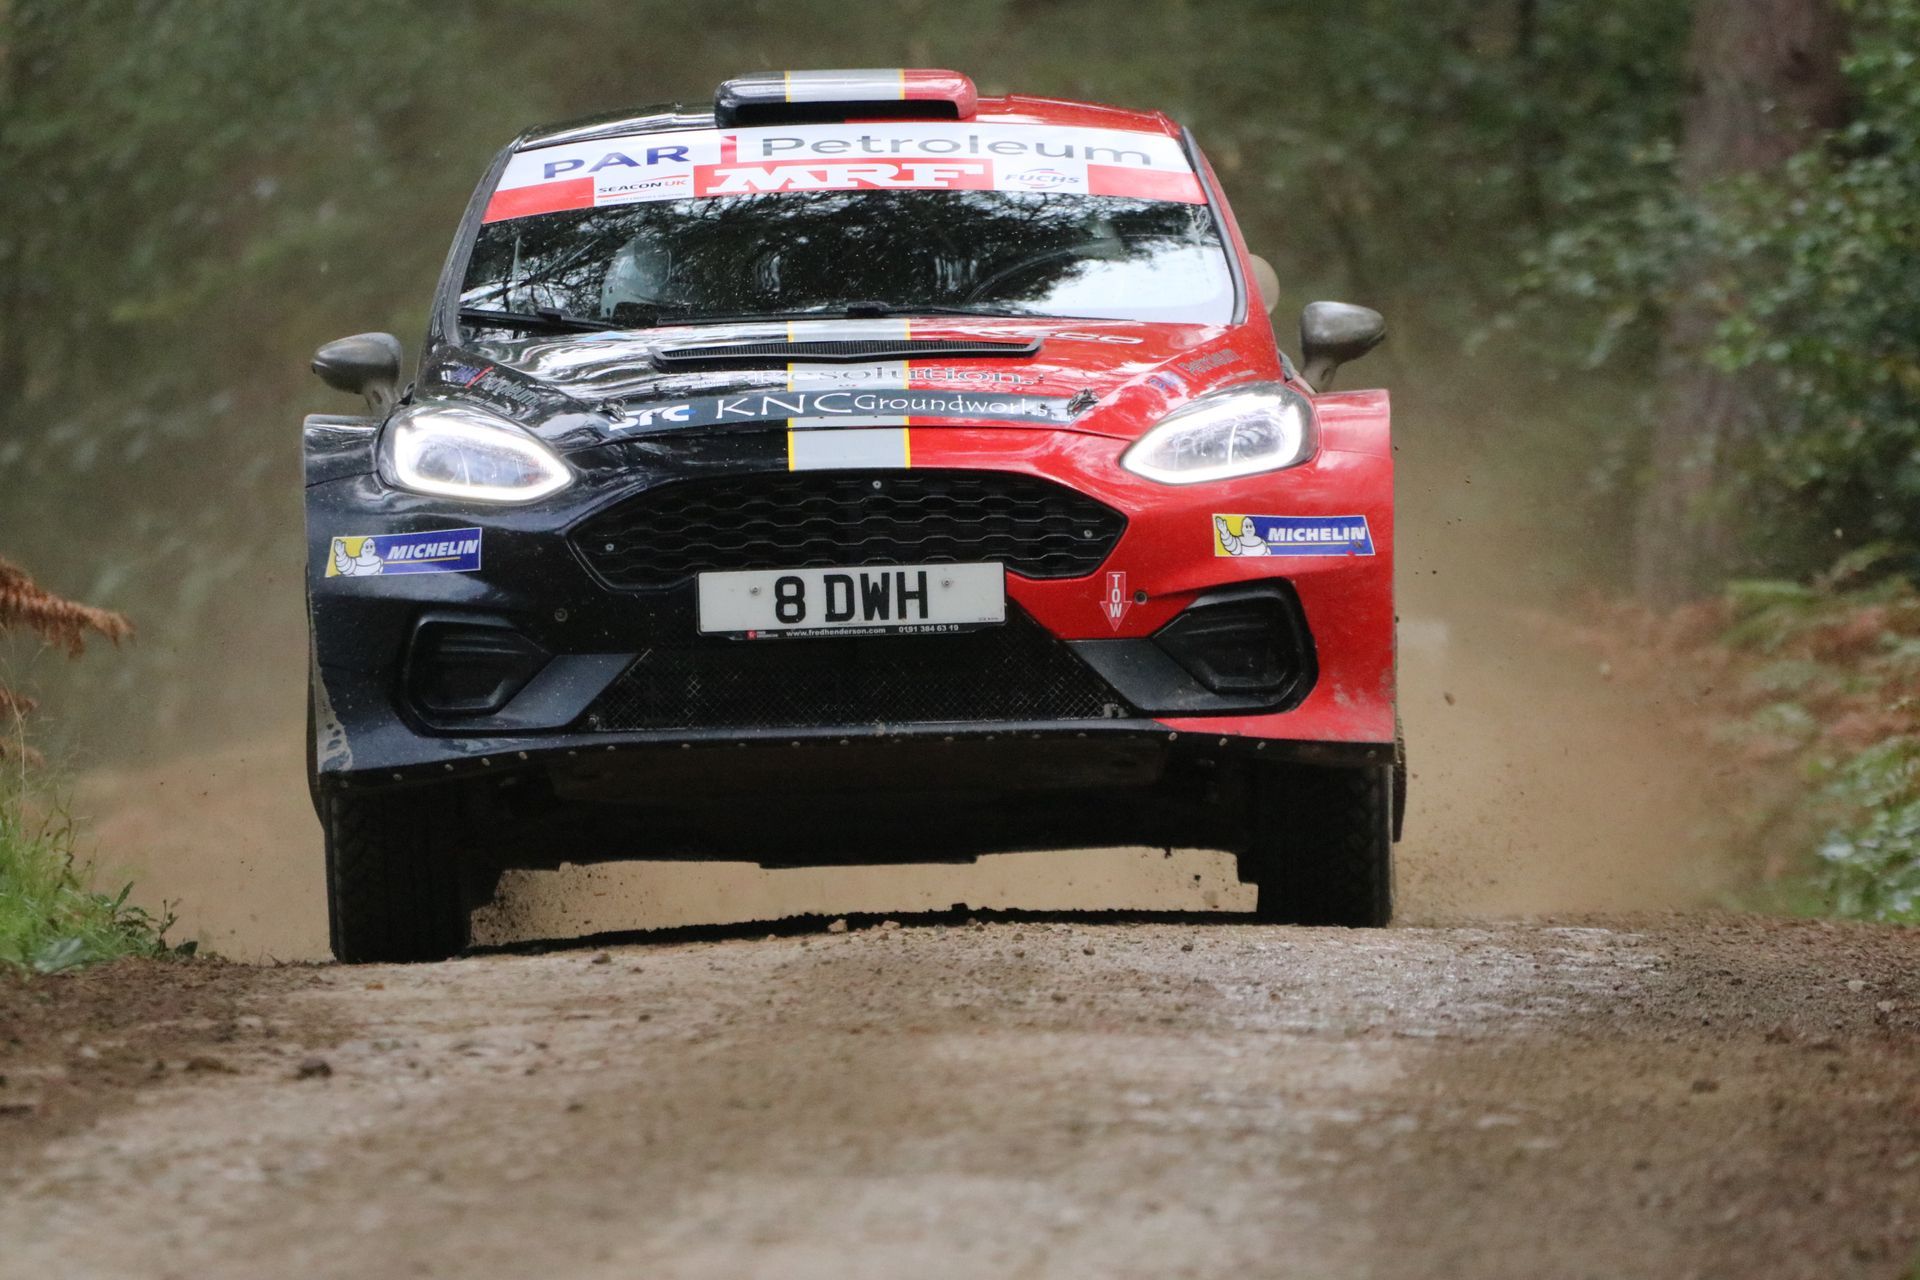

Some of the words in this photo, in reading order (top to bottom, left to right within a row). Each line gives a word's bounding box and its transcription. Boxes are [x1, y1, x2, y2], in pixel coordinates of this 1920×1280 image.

[543, 145, 691, 180] PAR
[762, 135, 1152, 166] Petroleum
[599, 181, 662, 194] SEACON
[664, 179, 687, 188] UK
[706, 162, 985, 194] MRF
[1004, 173, 1080, 185] FUCHS
[715, 392, 853, 419] KNC
[854, 394, 1049, 417] Groundworks
[1268, 526, 1366, 542] MICHELIN
[387, 539, 479, 560] MICHELIN
[774, 575, 806, 623] 8
[823, 570, 929, 623] DWH
[1109, 574, 1122, 618] TOW
[786, 627, 886, 637] www.fredhenderson.com
